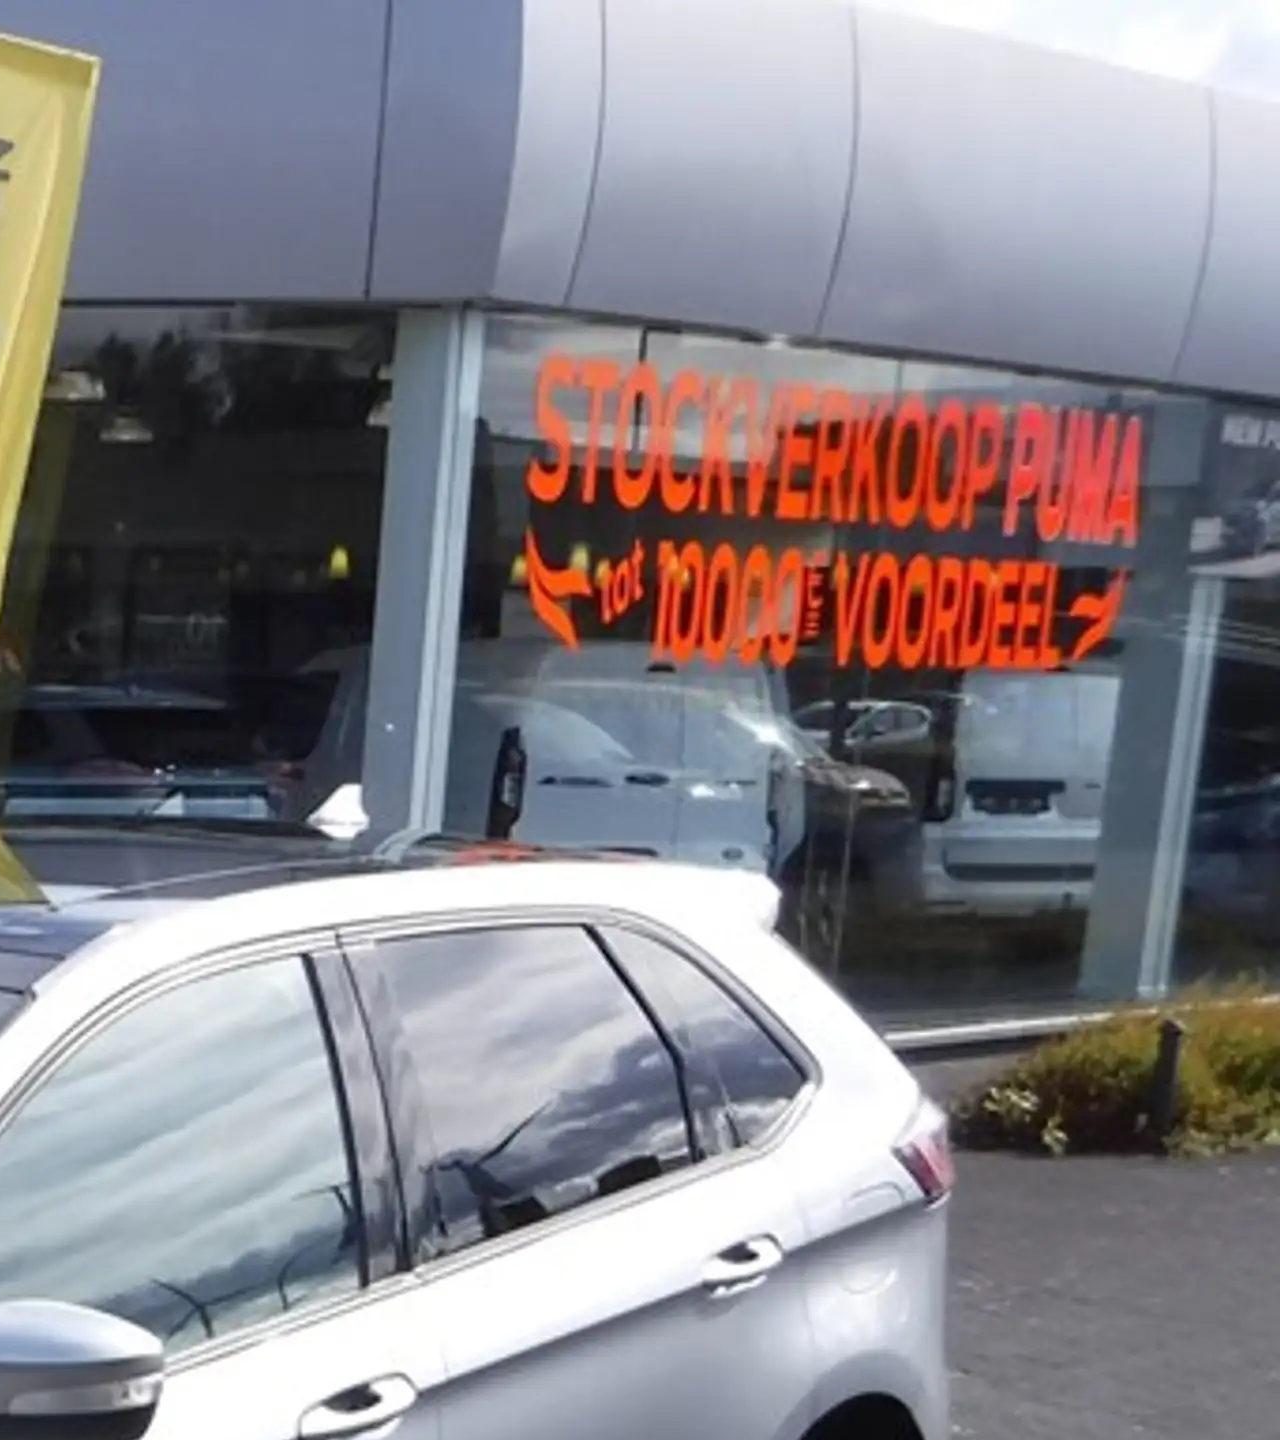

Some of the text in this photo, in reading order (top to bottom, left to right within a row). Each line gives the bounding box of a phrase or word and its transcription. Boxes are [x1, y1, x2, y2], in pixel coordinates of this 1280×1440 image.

[1002, 401, 1142, 548] PUMA
[650, 540, 803, 666] 10000
[833, 552, 1061, 669] VOORDEEL
